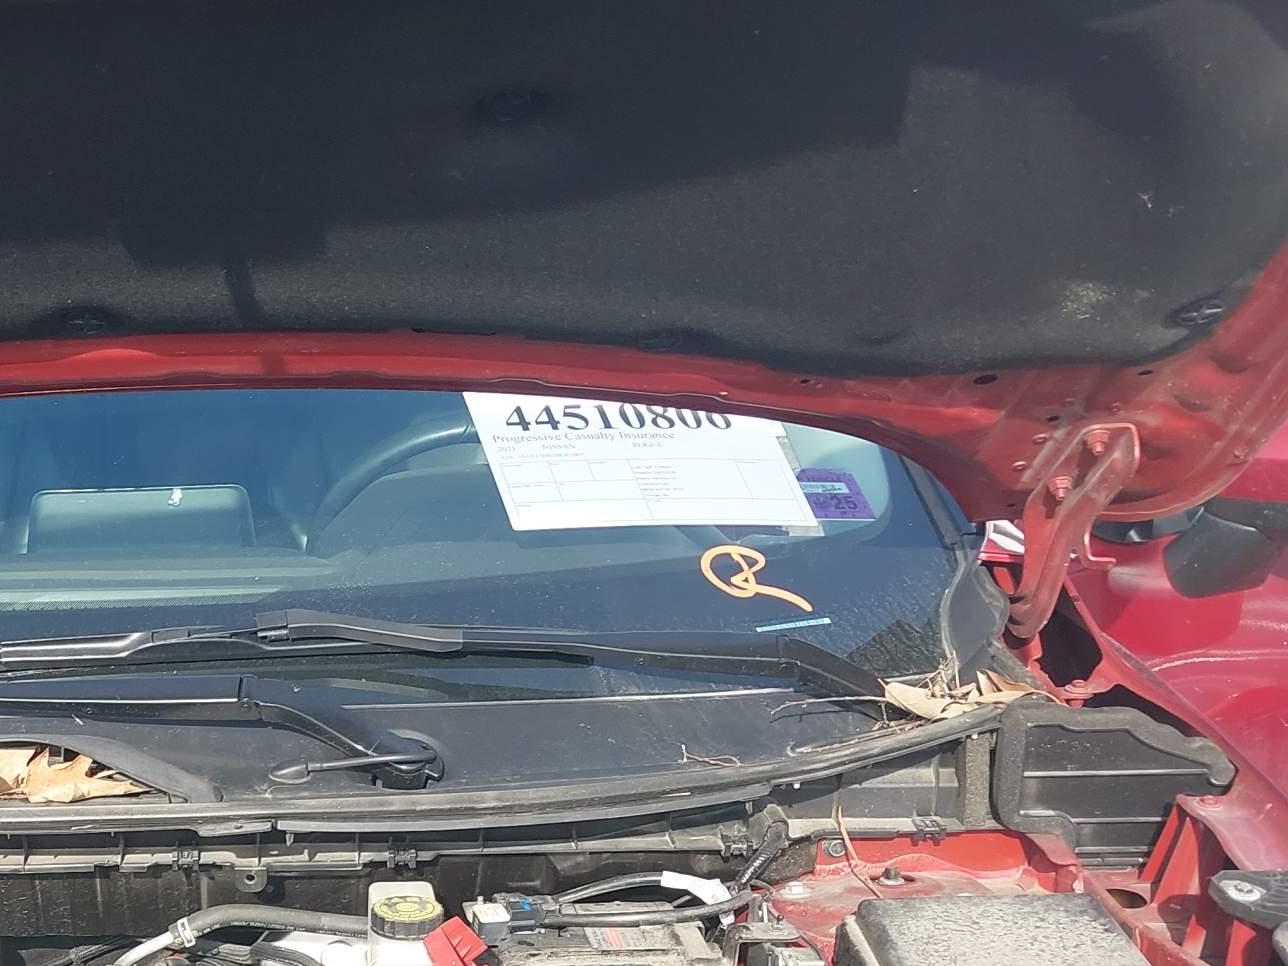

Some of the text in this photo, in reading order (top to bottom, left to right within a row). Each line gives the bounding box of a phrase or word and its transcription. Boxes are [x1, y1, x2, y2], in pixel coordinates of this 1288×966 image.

[505, 403, 732, 431] 44510806
[492, 430, 677, 444] Progressive Casualty Insurance
